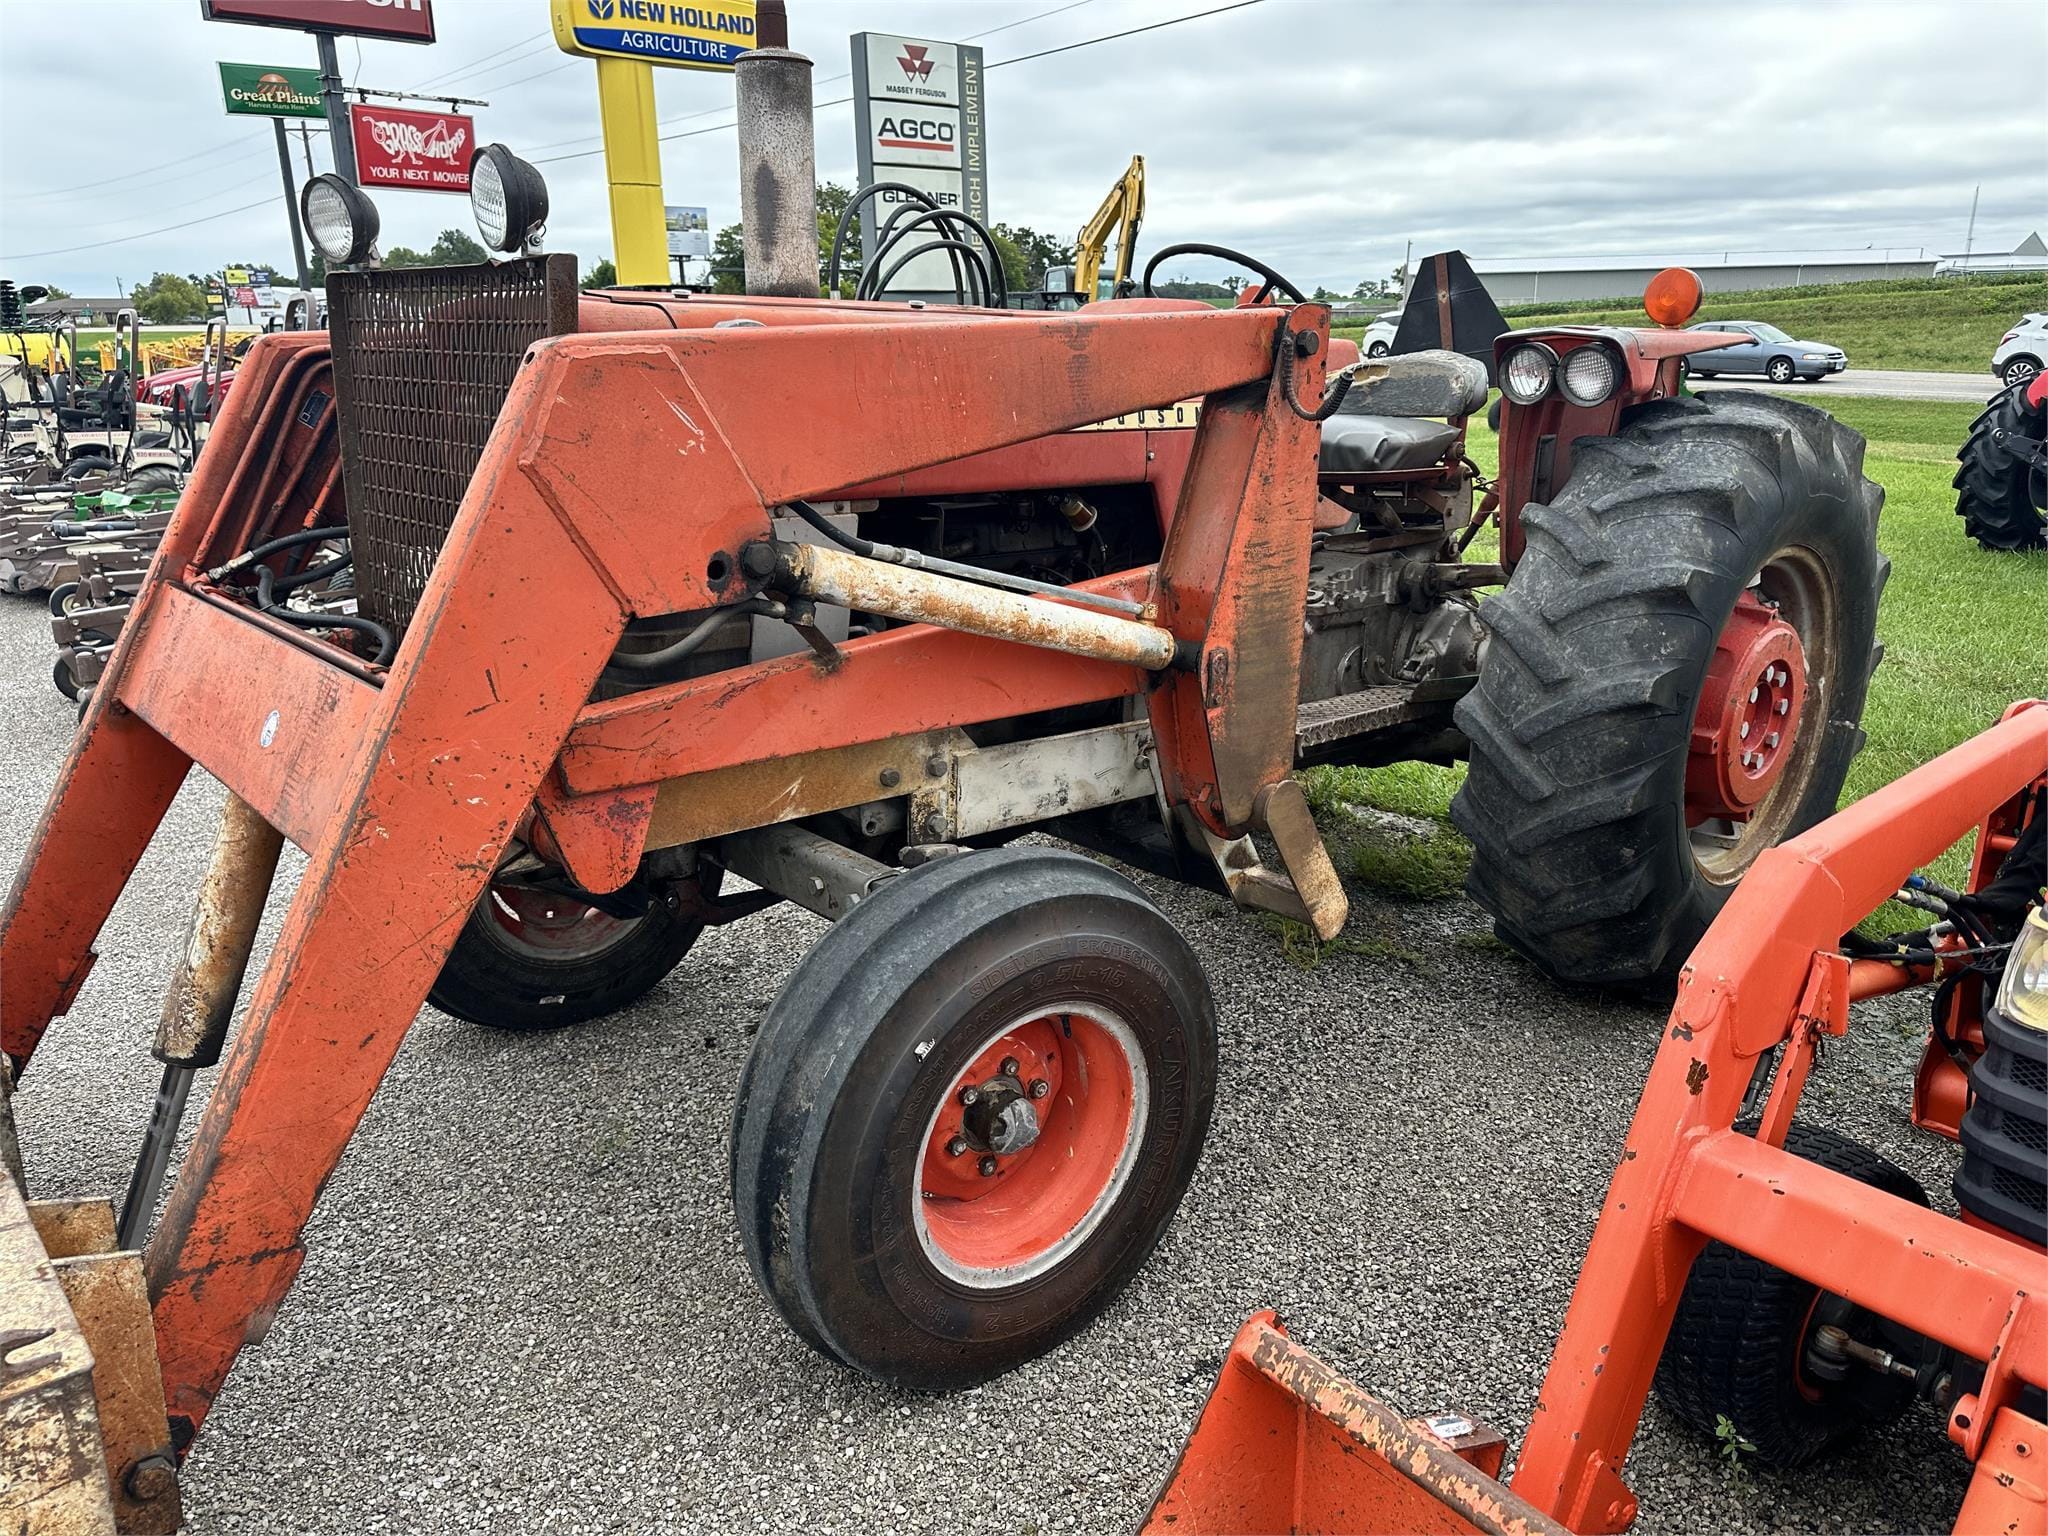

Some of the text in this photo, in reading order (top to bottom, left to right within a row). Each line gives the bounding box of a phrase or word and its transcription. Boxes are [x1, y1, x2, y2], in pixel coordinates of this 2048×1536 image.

[620, 0, 755, 36] NEW HOLLAND
[621, 31, 728, 59] AGRICULTURE
[230, 88, 321, 105] Great Plains
[886, 85, 947, 98] MASSEY FERGUSON
[964, 56, 981, 171] IMPLEMENT
[877, 117, 954, 142] AGCO
[370, 166, 400, 179] YOUR
[403, 168, 430, 181] NEXT
[883, 191, 958, 206] GLENER
[969, 940, 1169, 999] SIDEWALL PROTECTION
[1030, 963, 1128, 990] 9.5L-15
